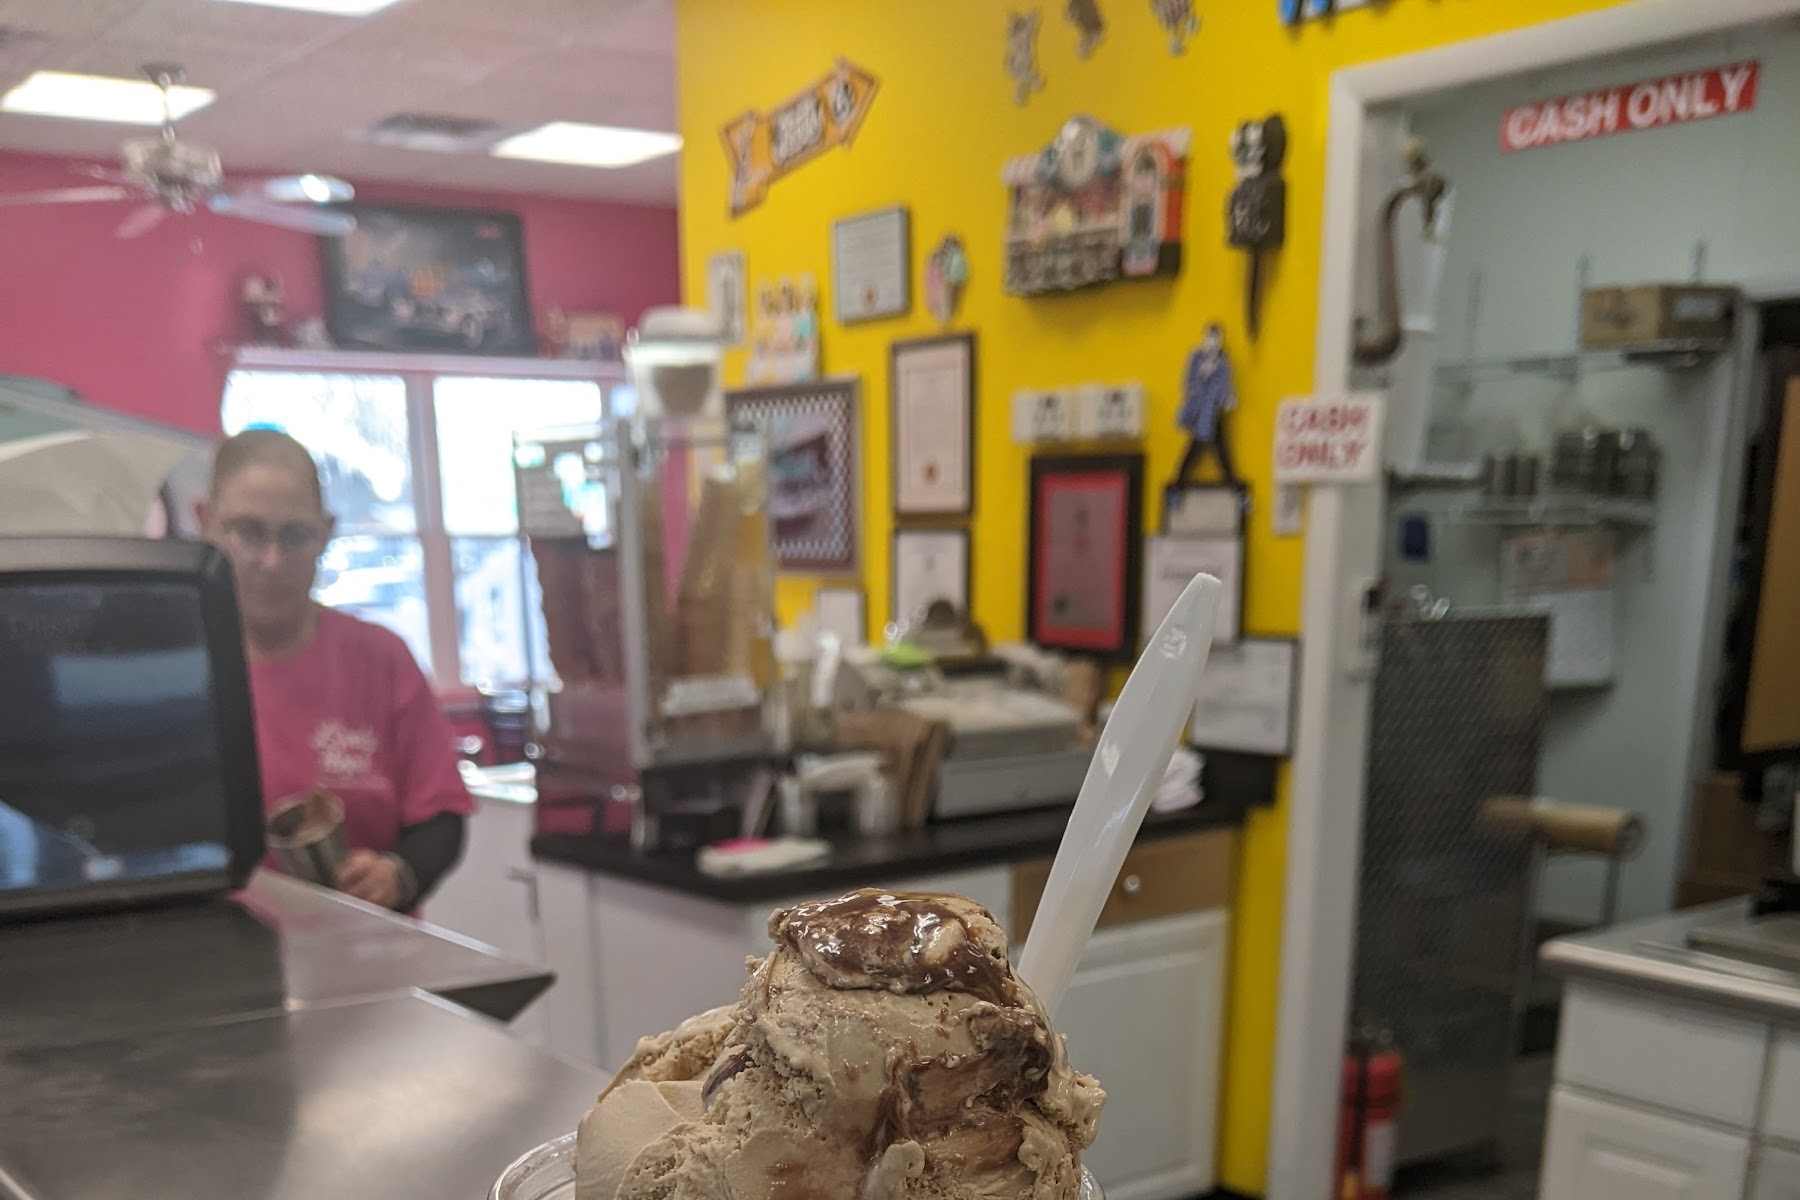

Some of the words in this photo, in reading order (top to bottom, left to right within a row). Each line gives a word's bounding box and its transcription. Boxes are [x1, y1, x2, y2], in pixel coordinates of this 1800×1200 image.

[1505, 90, 1621, 148] CASH
[1626, 66, 1751, 128] ONLY
[1281, 404, 1367, 435] CASH
[1278, 440, 1367, 468] ONLY
